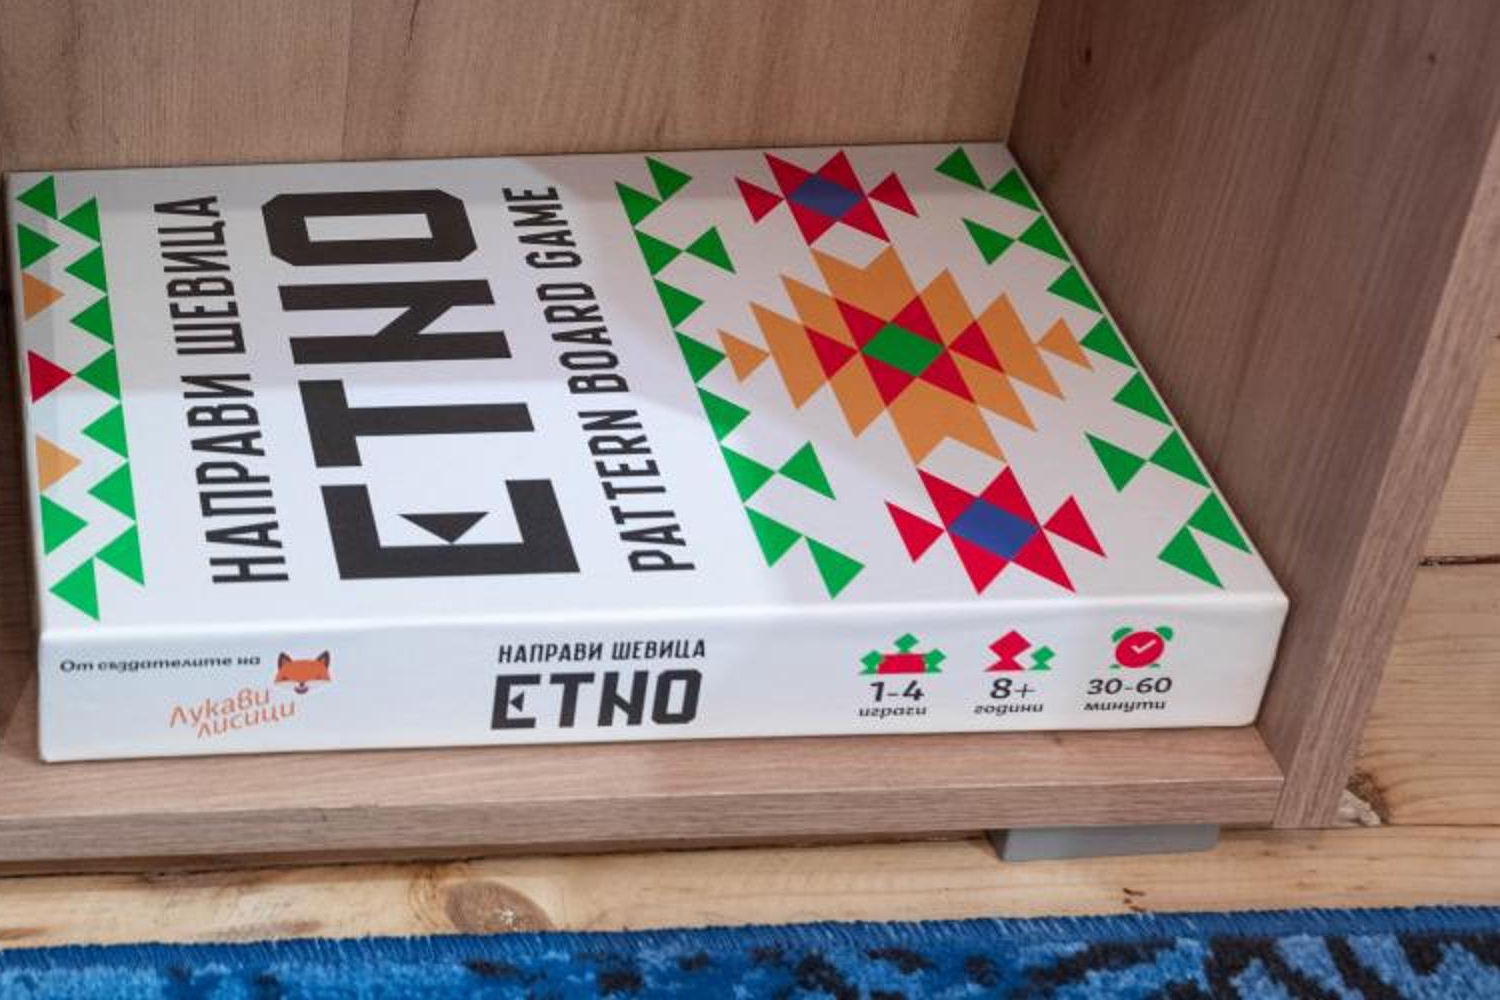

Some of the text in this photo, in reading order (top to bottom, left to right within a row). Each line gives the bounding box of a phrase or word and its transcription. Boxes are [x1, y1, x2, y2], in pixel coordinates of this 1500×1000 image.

[153, 196, 290, 583] НАПРАВИ ШЕВИЦА
[261, 188, 581, 580] ETNO
[501, 186, 696, 572] PATTERN BOARD GAME
[498, 638, 706, 663] НАПРАВИ ШЕВИЦА
[60, 658, 94, 672] От
[237, 655, 261, 666] на
[869, 680, 925, 701] 1-4
[990, 677, 1036, 699] 8+
[1087, 677, 1173, 695] 30-60
[170, 687, 269, 728] Лукави
[491, 668, 703, 730] ETNO
[973, 703, 1044, 717] години
[1083, 699, 1166, 712] минути
[197, 702, 296, 738] лисици
